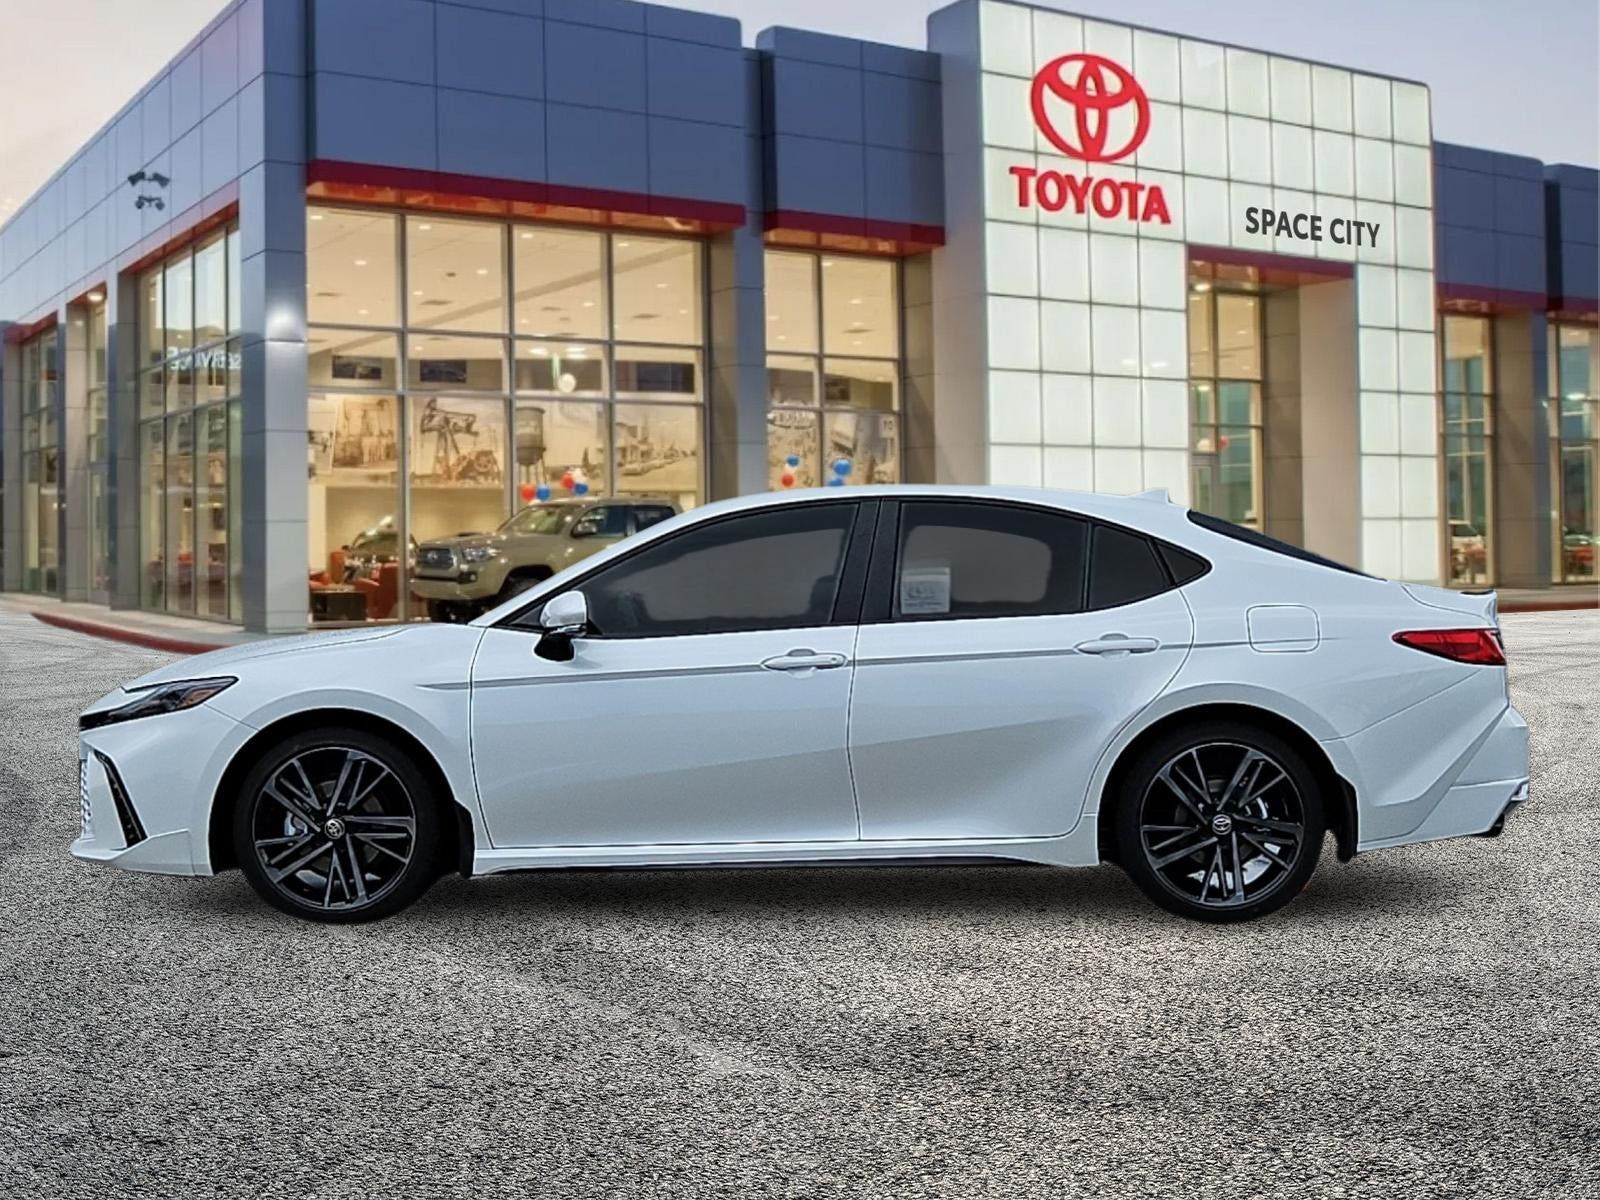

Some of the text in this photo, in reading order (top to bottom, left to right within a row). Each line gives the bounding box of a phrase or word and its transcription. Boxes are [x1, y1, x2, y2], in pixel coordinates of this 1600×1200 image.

[1009, 166, 1171, 224] TOYOTA
[1245, 206, 1380, 248] SPACE CITY
